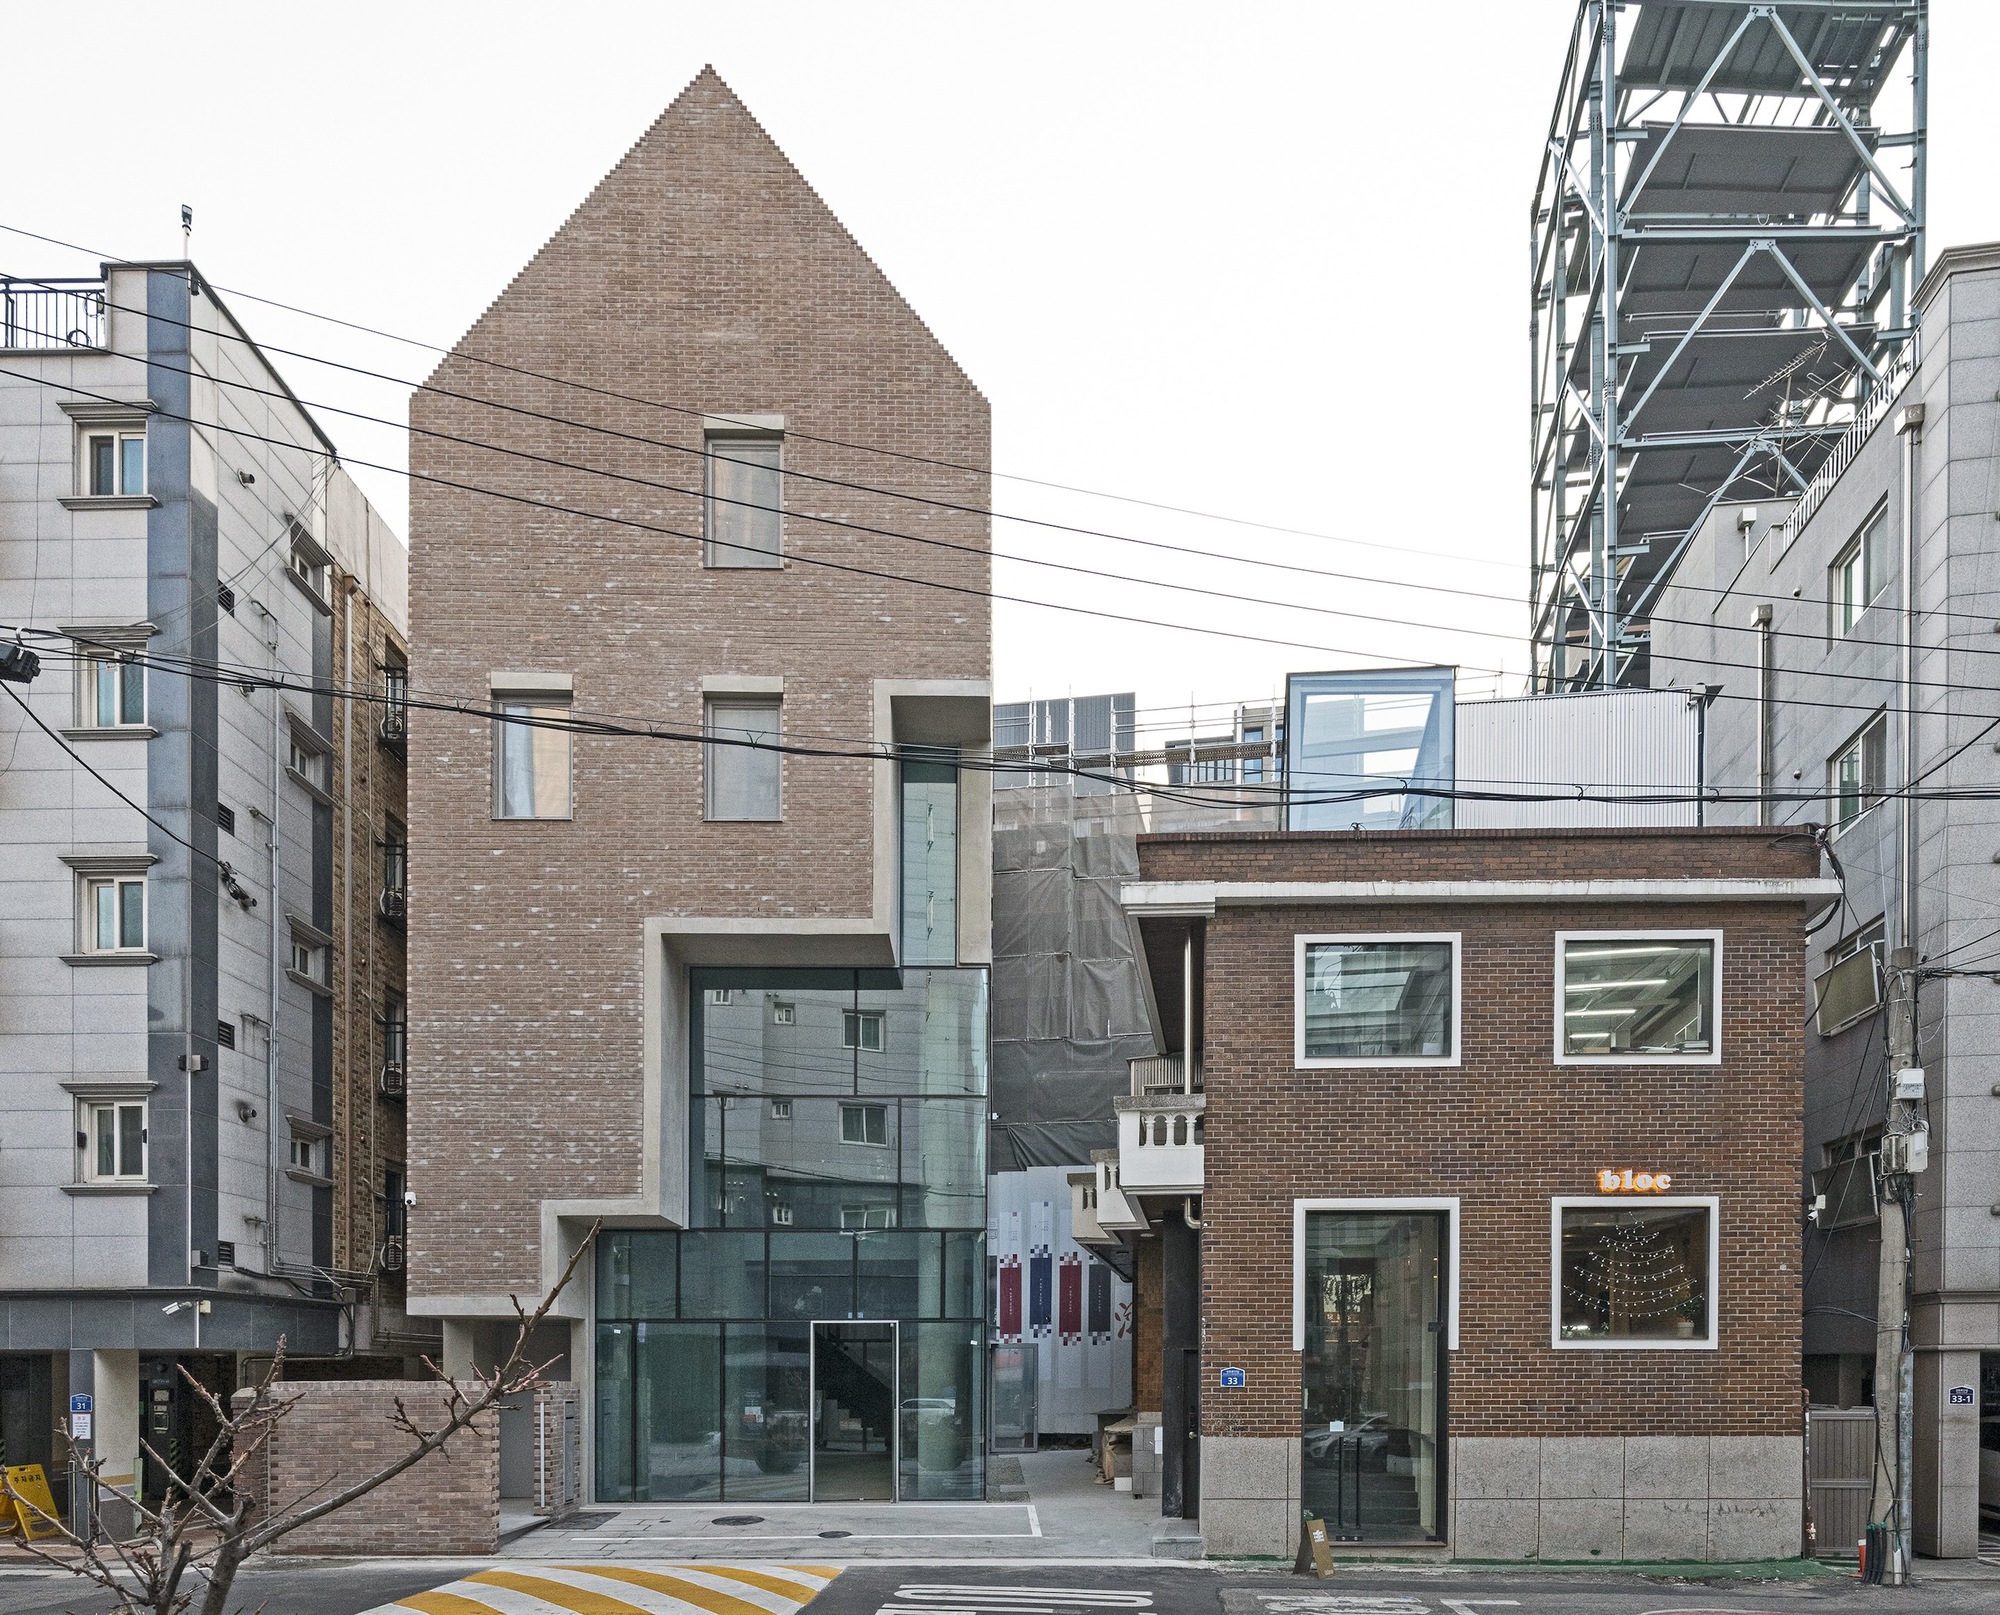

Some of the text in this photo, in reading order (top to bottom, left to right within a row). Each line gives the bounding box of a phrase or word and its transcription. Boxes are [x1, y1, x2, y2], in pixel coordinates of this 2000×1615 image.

[1602, 1169, 1671, 1190] bloc
[1227, 1377, 1238, 1385] 33
[1951, 1395, 1971, 1403] 33-1
[76, 1402, 86, 1410] 31
